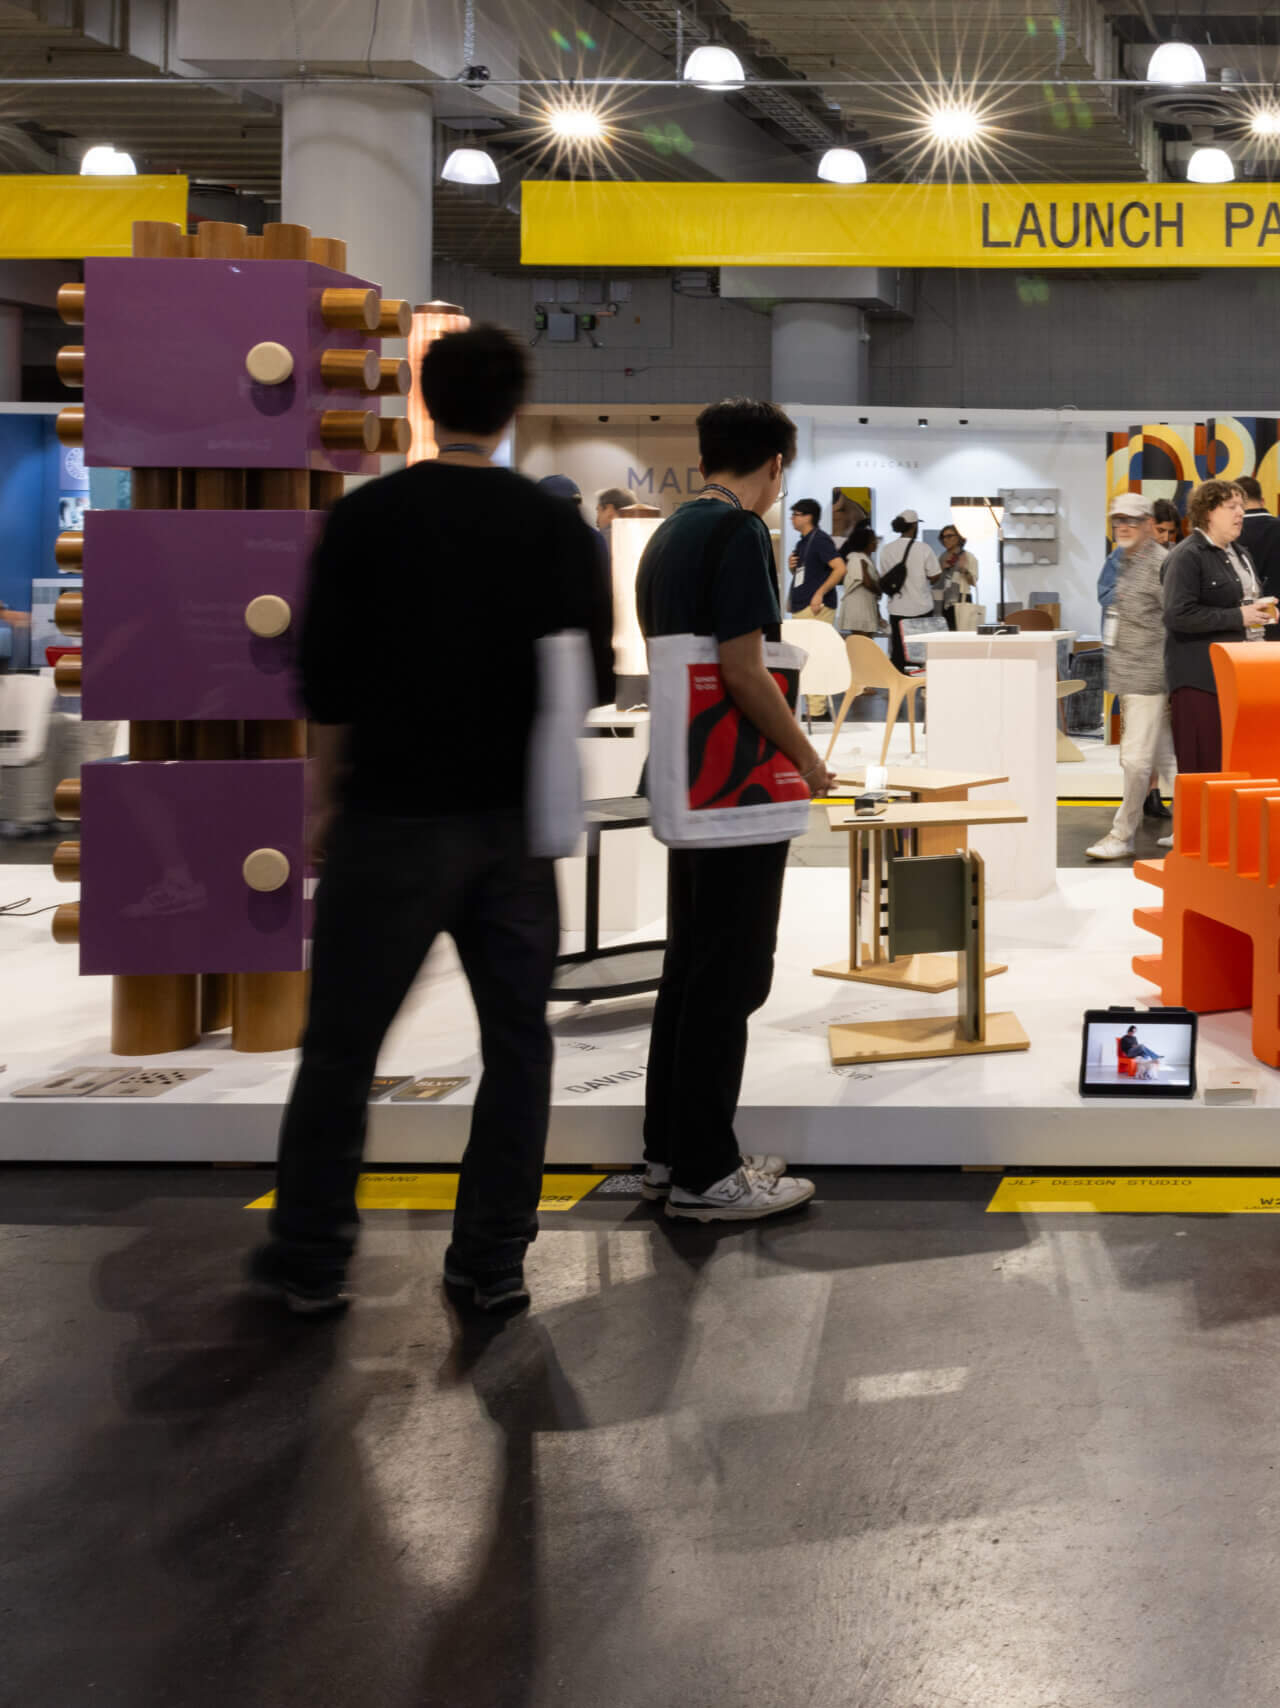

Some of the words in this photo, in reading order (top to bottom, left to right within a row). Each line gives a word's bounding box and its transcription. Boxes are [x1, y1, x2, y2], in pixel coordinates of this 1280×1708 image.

[982, 201, 1184, 249] LAUNCH
[563, 1070, 645, 1094] DAVID
[1007, 1178, 1041, 1186] JLF
[1050, 1178, 1116, 1187] DESIGN
[1126, 1178, 1193, 1187] STUDIO
